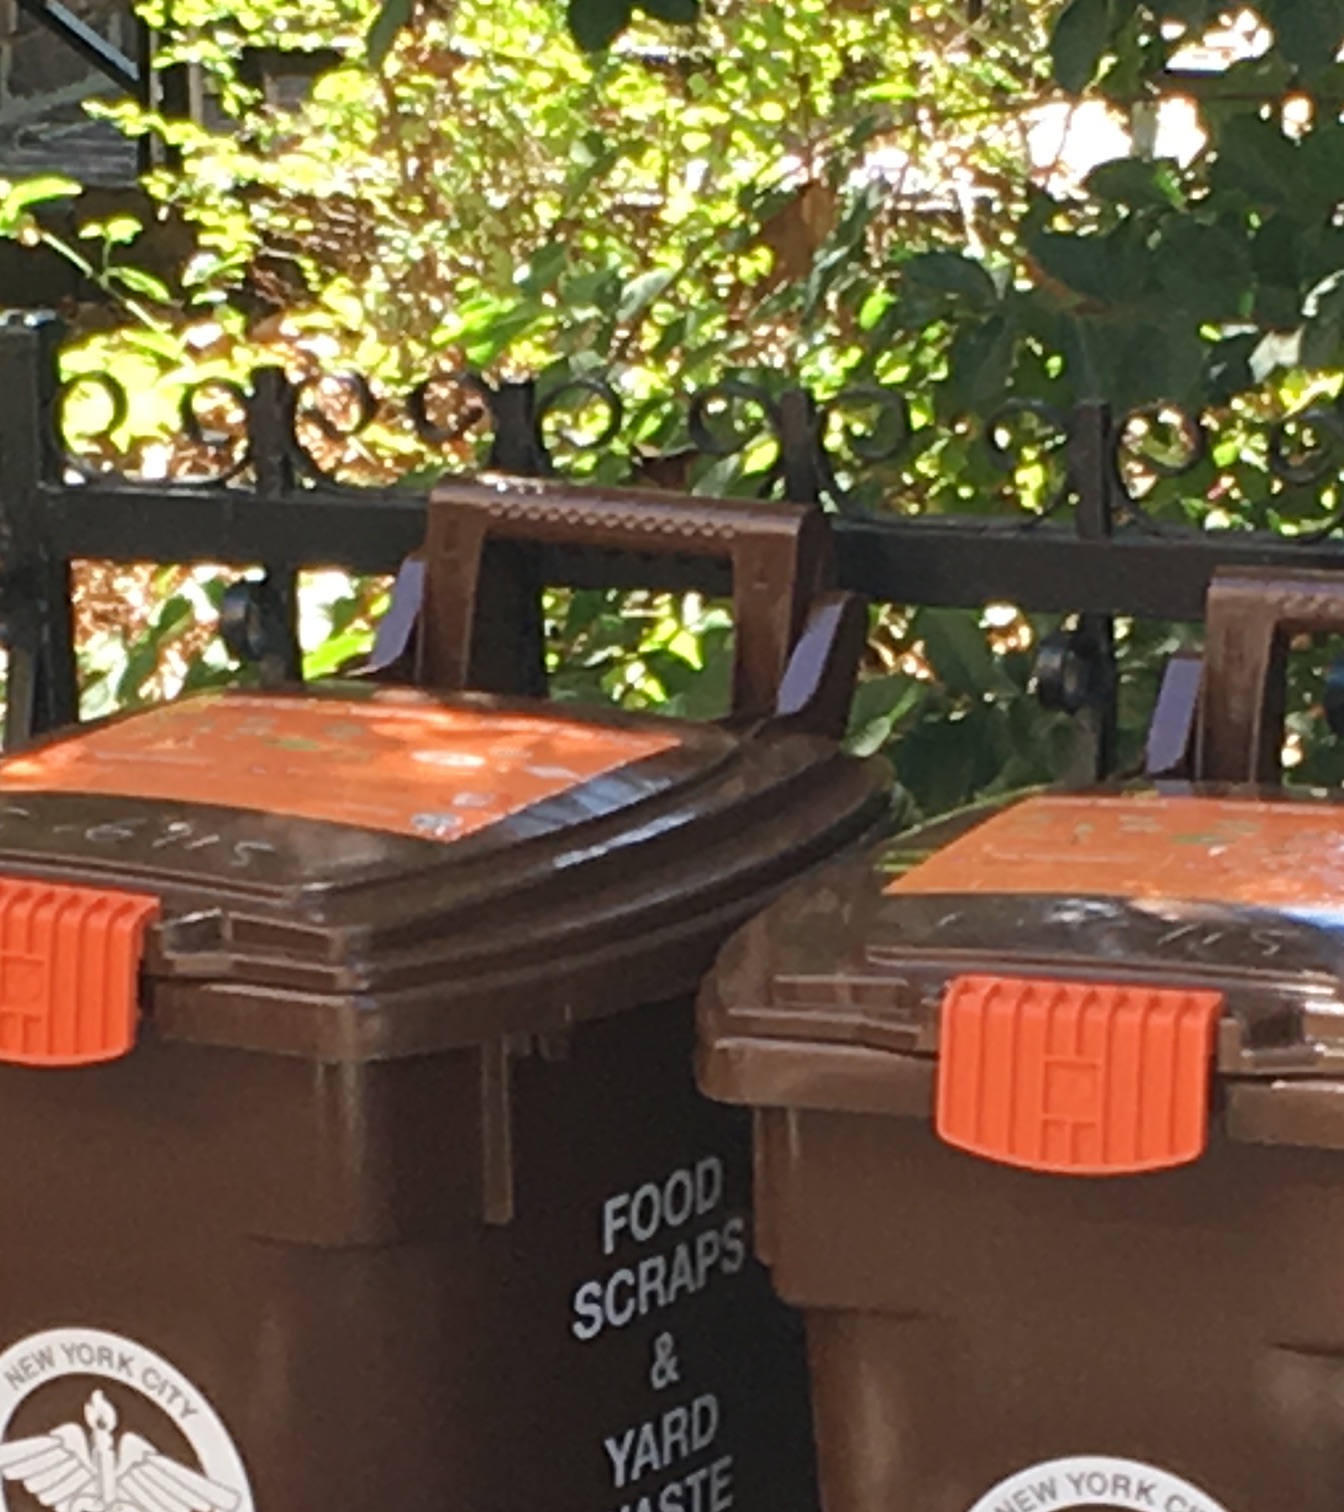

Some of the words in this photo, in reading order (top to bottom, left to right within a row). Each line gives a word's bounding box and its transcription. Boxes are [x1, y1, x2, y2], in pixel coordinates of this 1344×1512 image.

[602, 1156, 723, 1255] FOOD
[571, 1217, 745, 1341] SCRAPS
[4, 1344, 57, 1391] NEW
[60, 1342, 135, 1379] YORK
[140, 1366, 199, 1420] CITY
[650, 1331, 680, 1390] &
[604, 1393, 720, 1489] YARD
[1066, 1471, 1157, 1507] YORK
